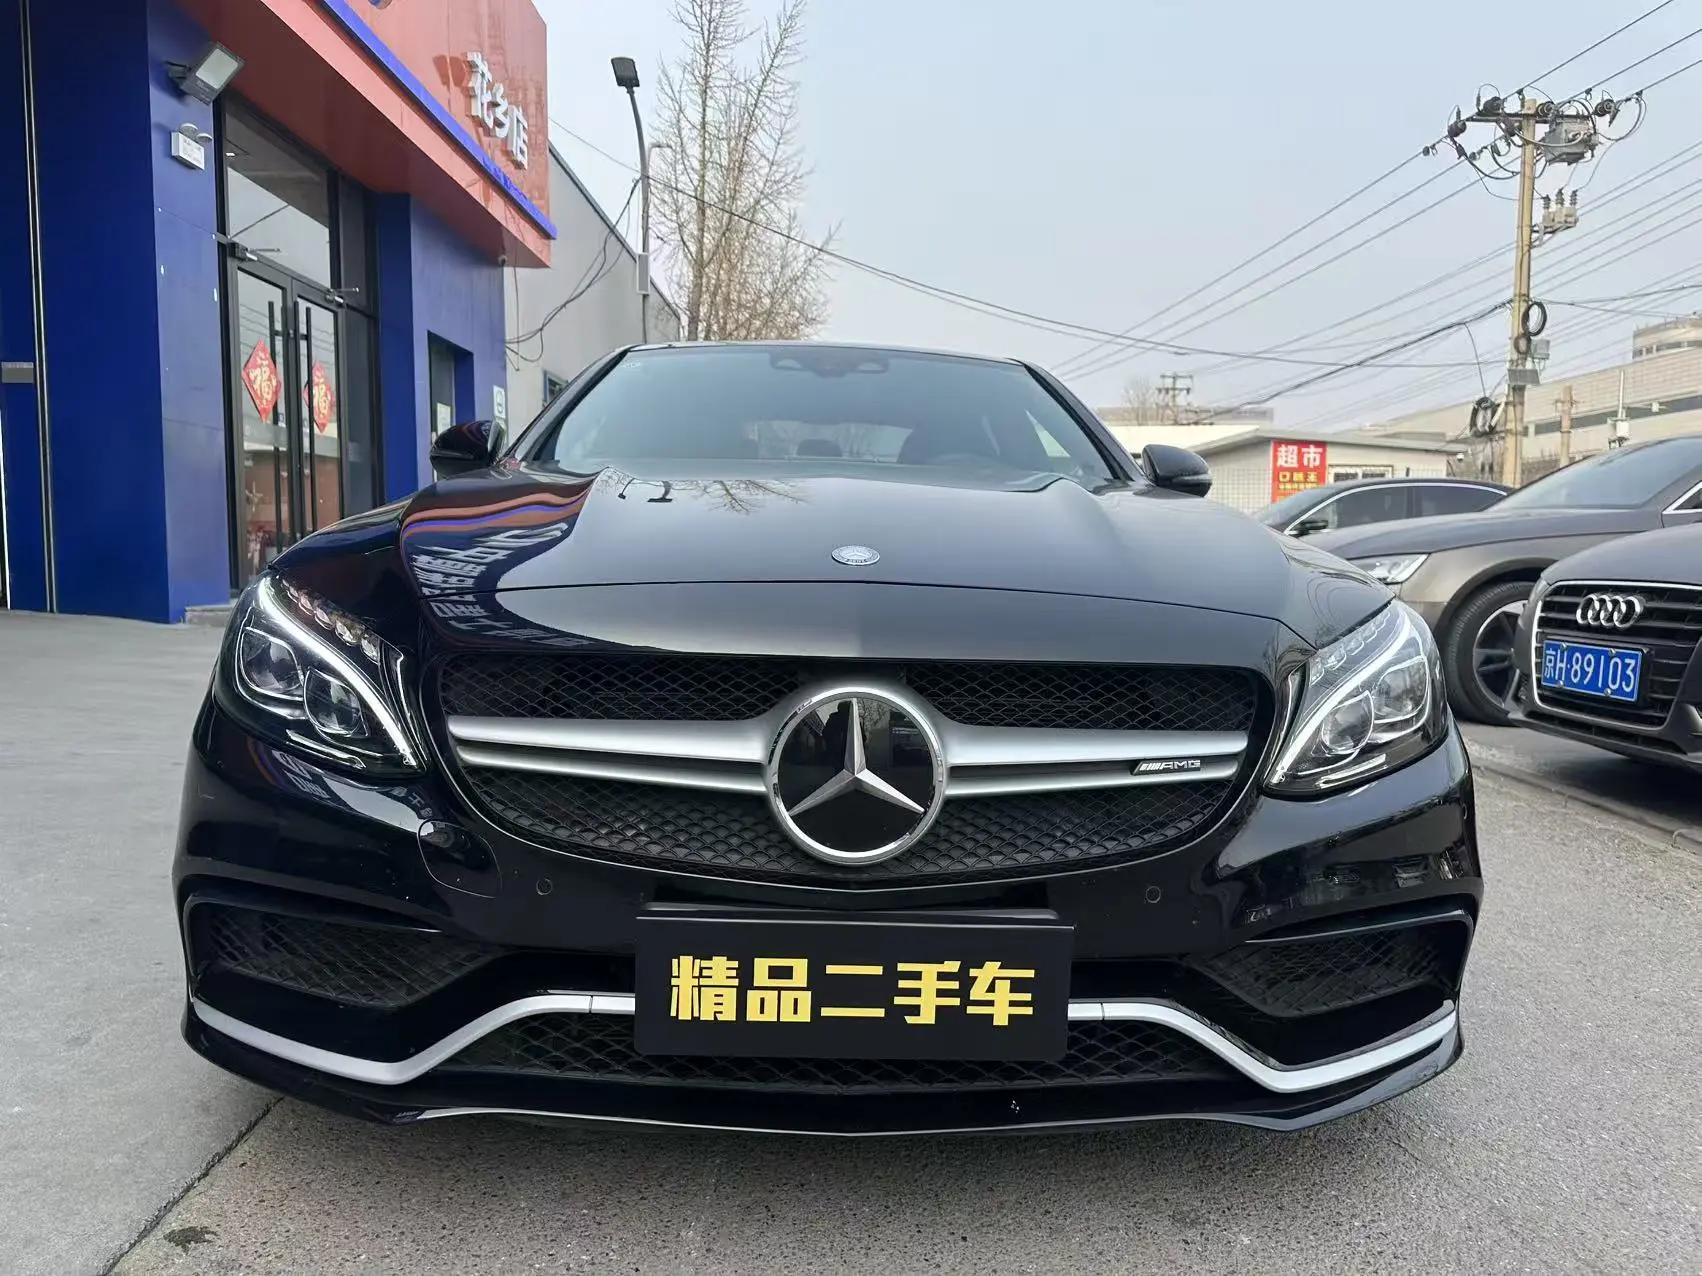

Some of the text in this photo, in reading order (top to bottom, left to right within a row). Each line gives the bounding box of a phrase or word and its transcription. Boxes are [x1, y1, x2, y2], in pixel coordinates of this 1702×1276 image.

[466, 51, 528, 170] 花乡店
[249, 350, 276, 405] 福
[1277, 444, 1323, 468] 超市
[1159, 760, 1201, 770] AMG
[670, 955, 1036, 1026] 精品二手车
